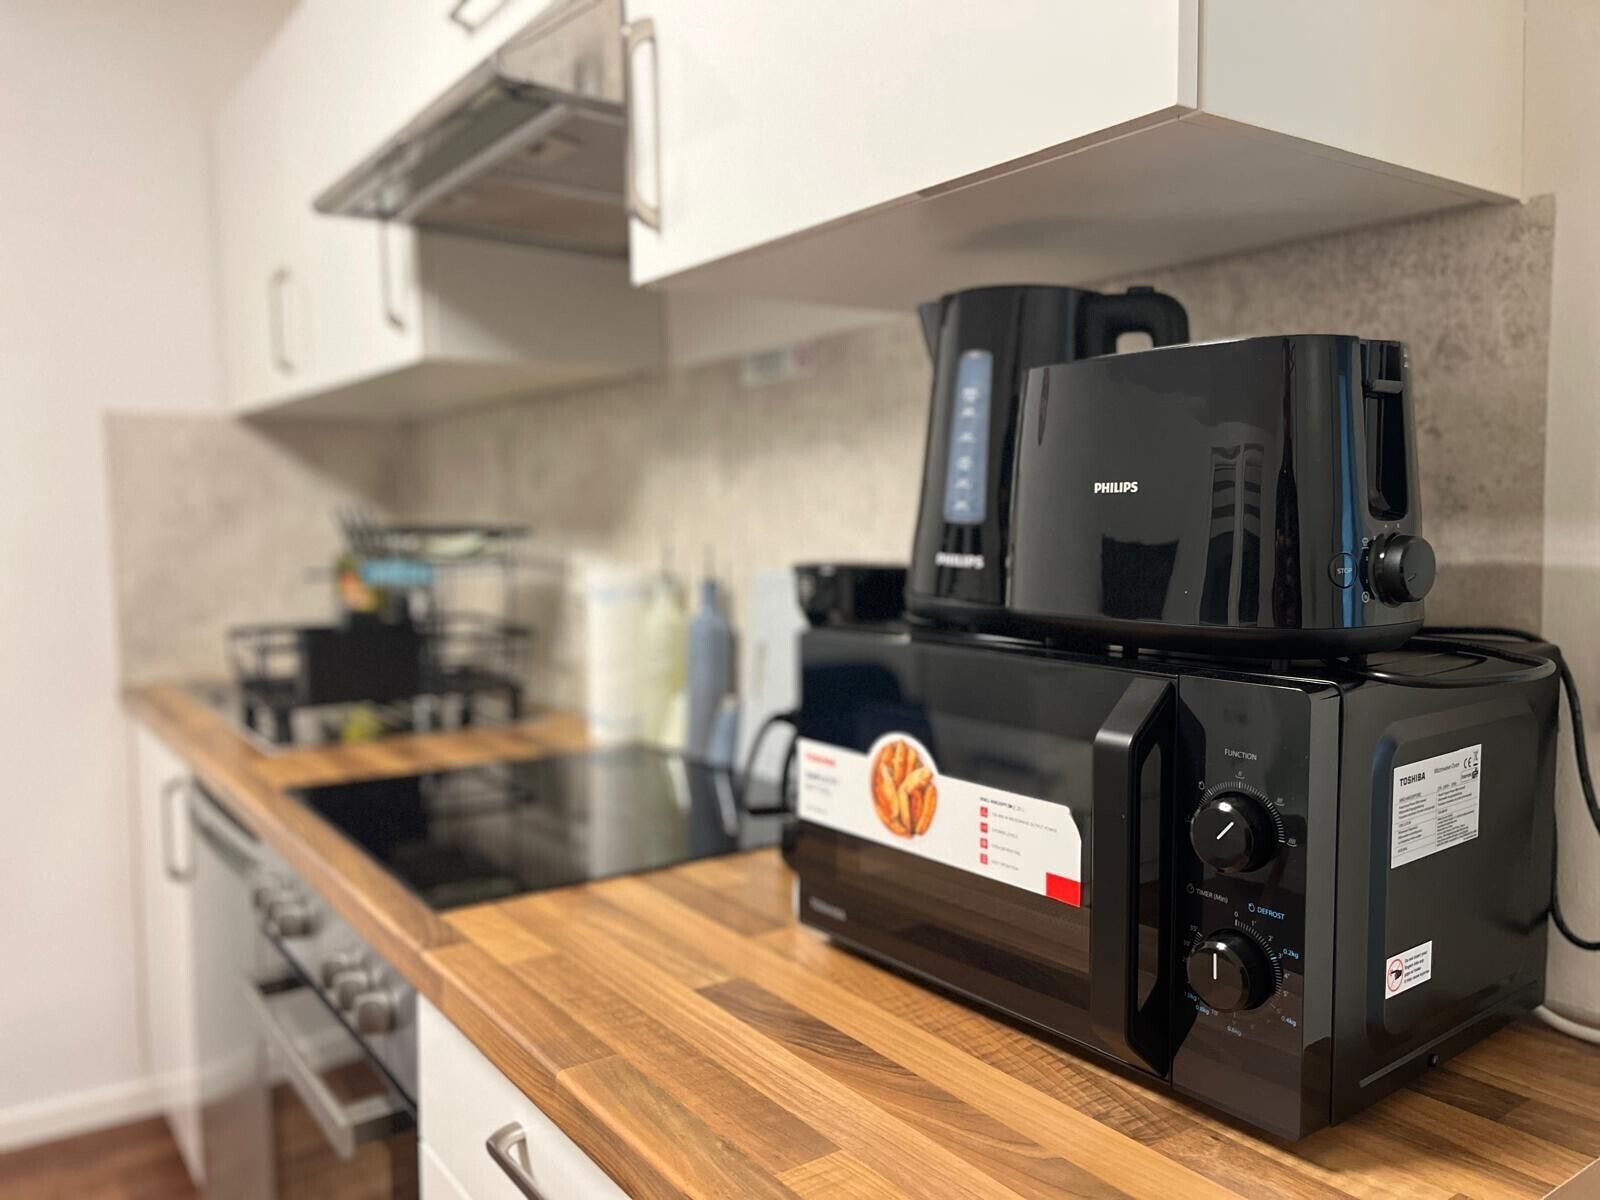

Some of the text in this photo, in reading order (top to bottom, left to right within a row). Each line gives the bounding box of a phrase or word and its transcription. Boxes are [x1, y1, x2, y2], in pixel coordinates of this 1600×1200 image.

[1093, 480, 1138, 494] PHILIPS
[935, 551, 985, 570] PHILIPS
[1336, 567, 1353, 575] STOP
[1224, 748, 1257, 761] FUNCTION
[1400, 772, 1426, 787] TOSHIBA
[1196, 888, 1214, 899] TIMER
[1257, 906, 1285, 920] DEFROST
